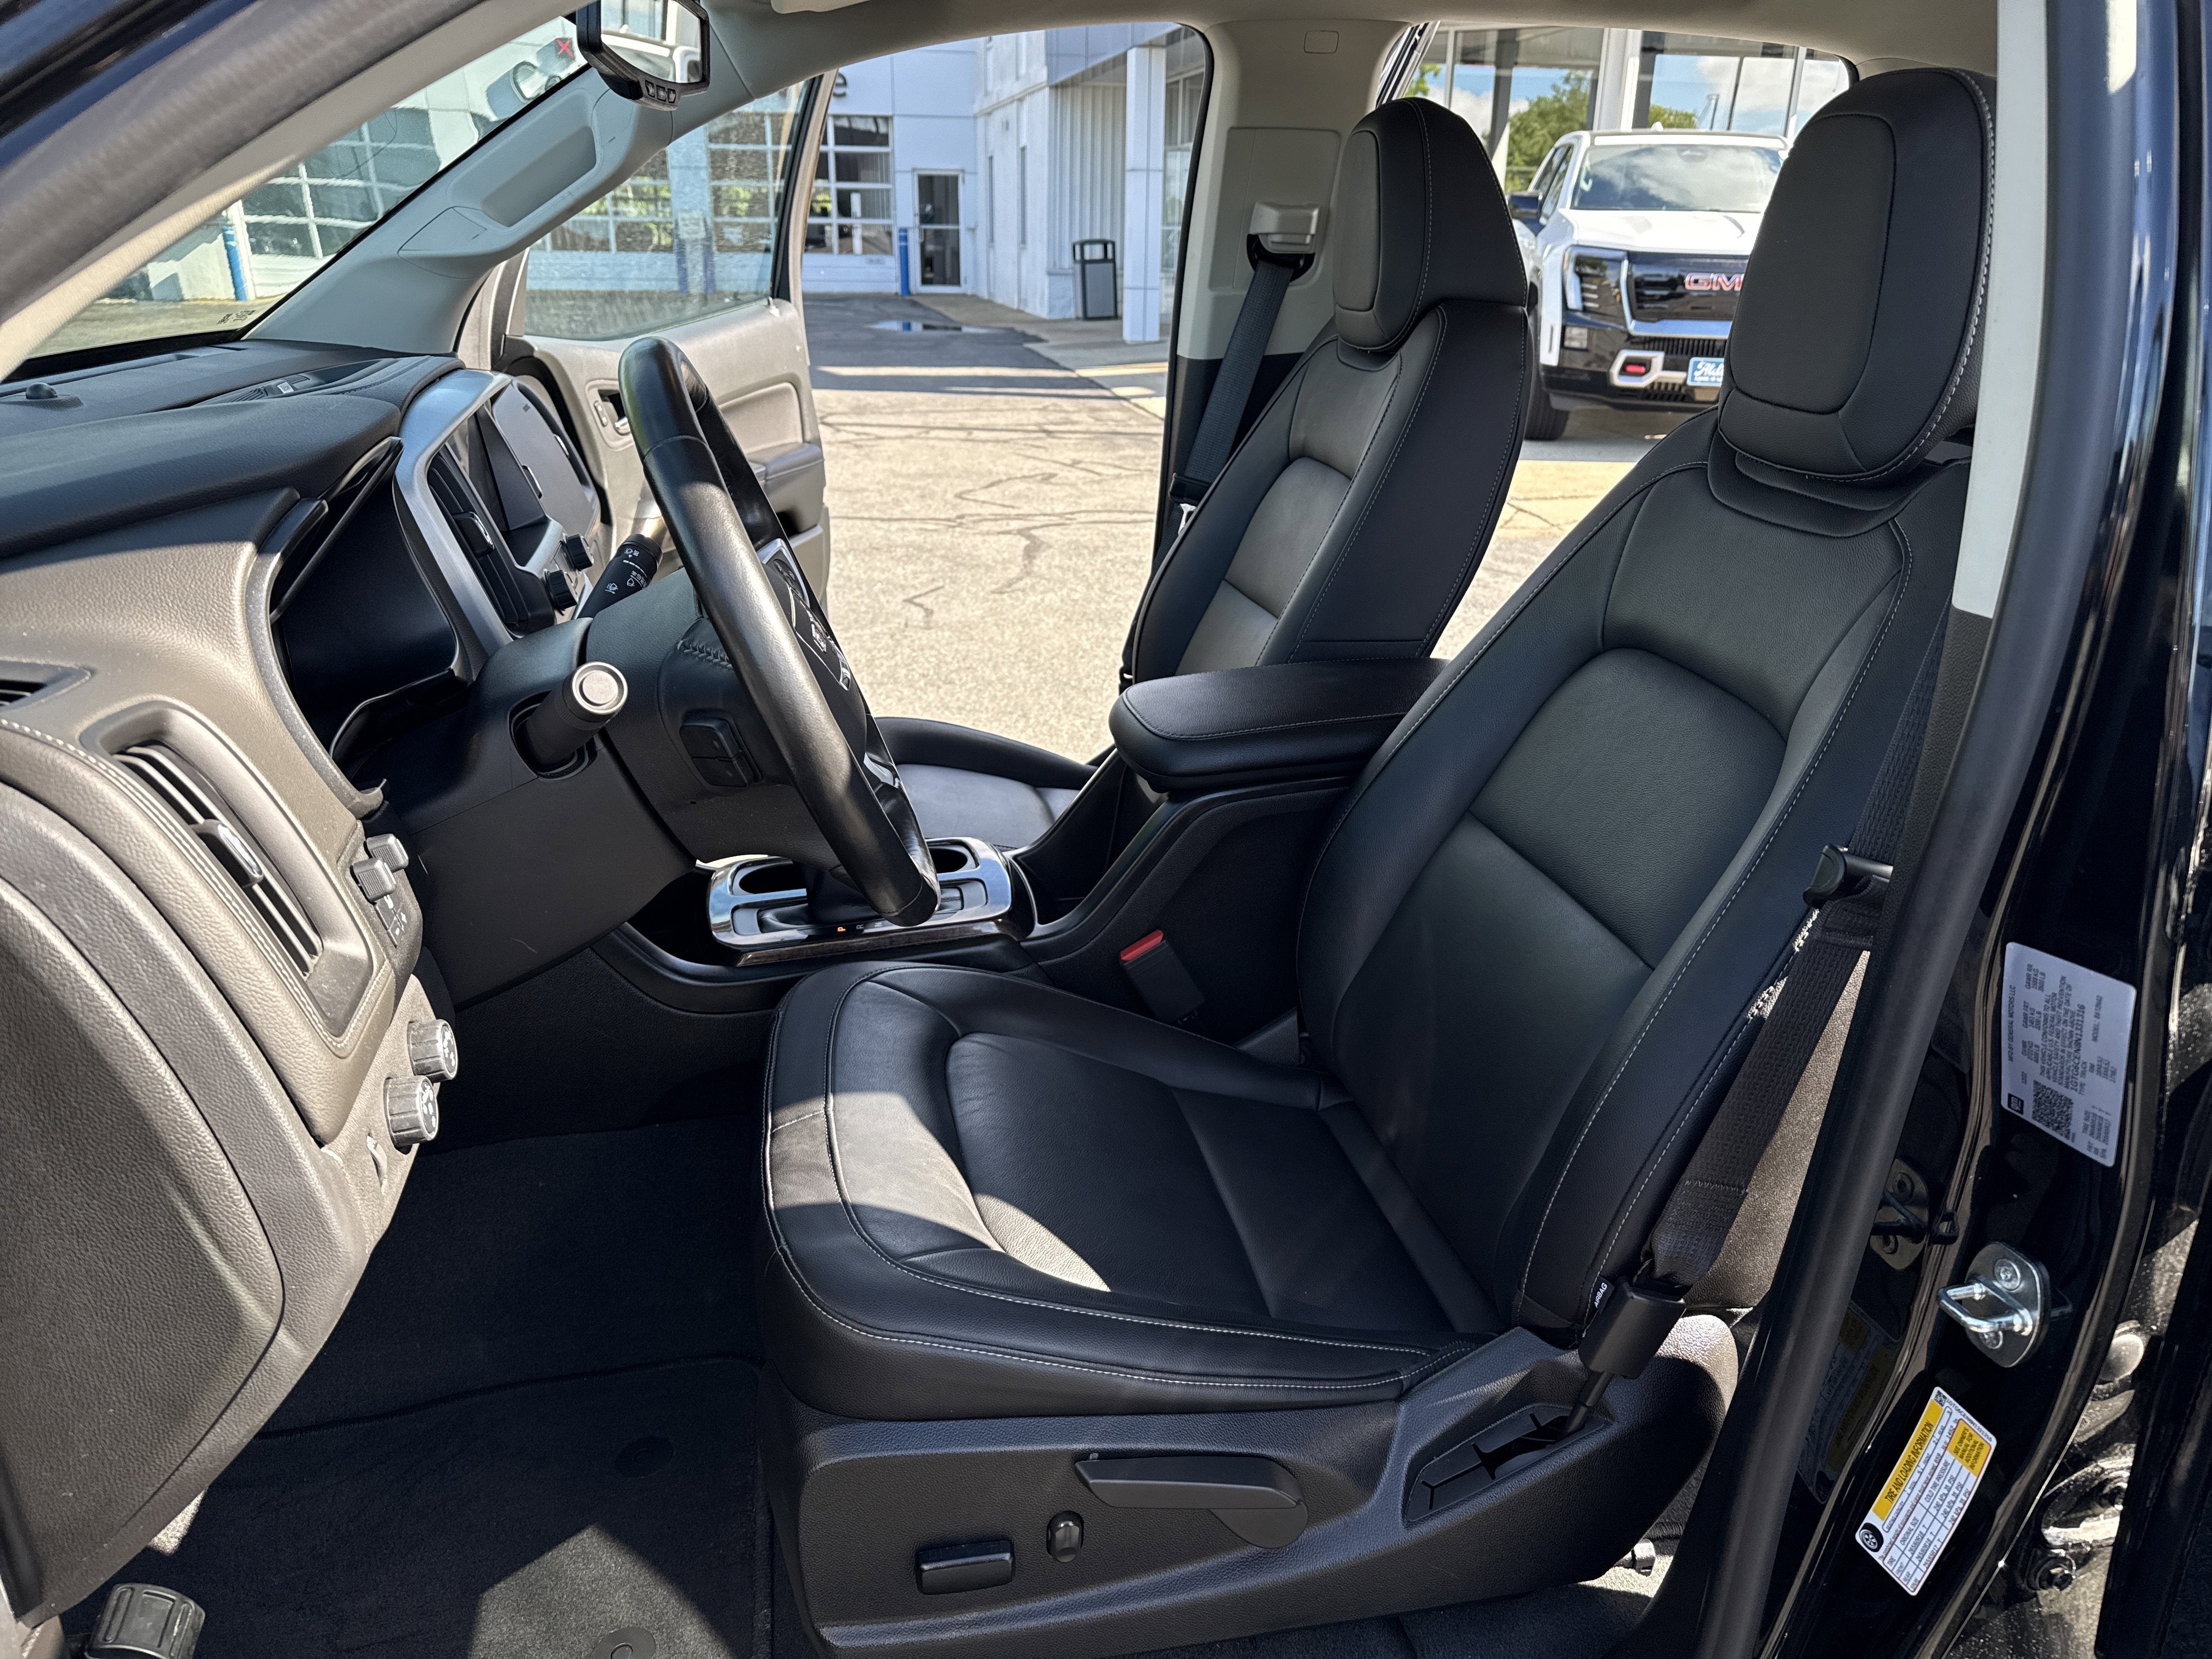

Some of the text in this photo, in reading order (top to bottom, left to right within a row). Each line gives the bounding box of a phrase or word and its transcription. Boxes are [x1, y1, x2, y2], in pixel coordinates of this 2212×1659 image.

[1685, 273, 1745, 291] GM
[1594, 1282, 1607, 1308] AIRBAG
[1884, 1419, 1934, 1504] TIRE AND LOADING INFORMATION
[1923, 1459, 1950, 1504] COLD TIRE PRESSURE
[1899, 1515, 1919, 1547] ORIGINAL SIZE
[1887, 1555, 1896, 1567] TIRE
